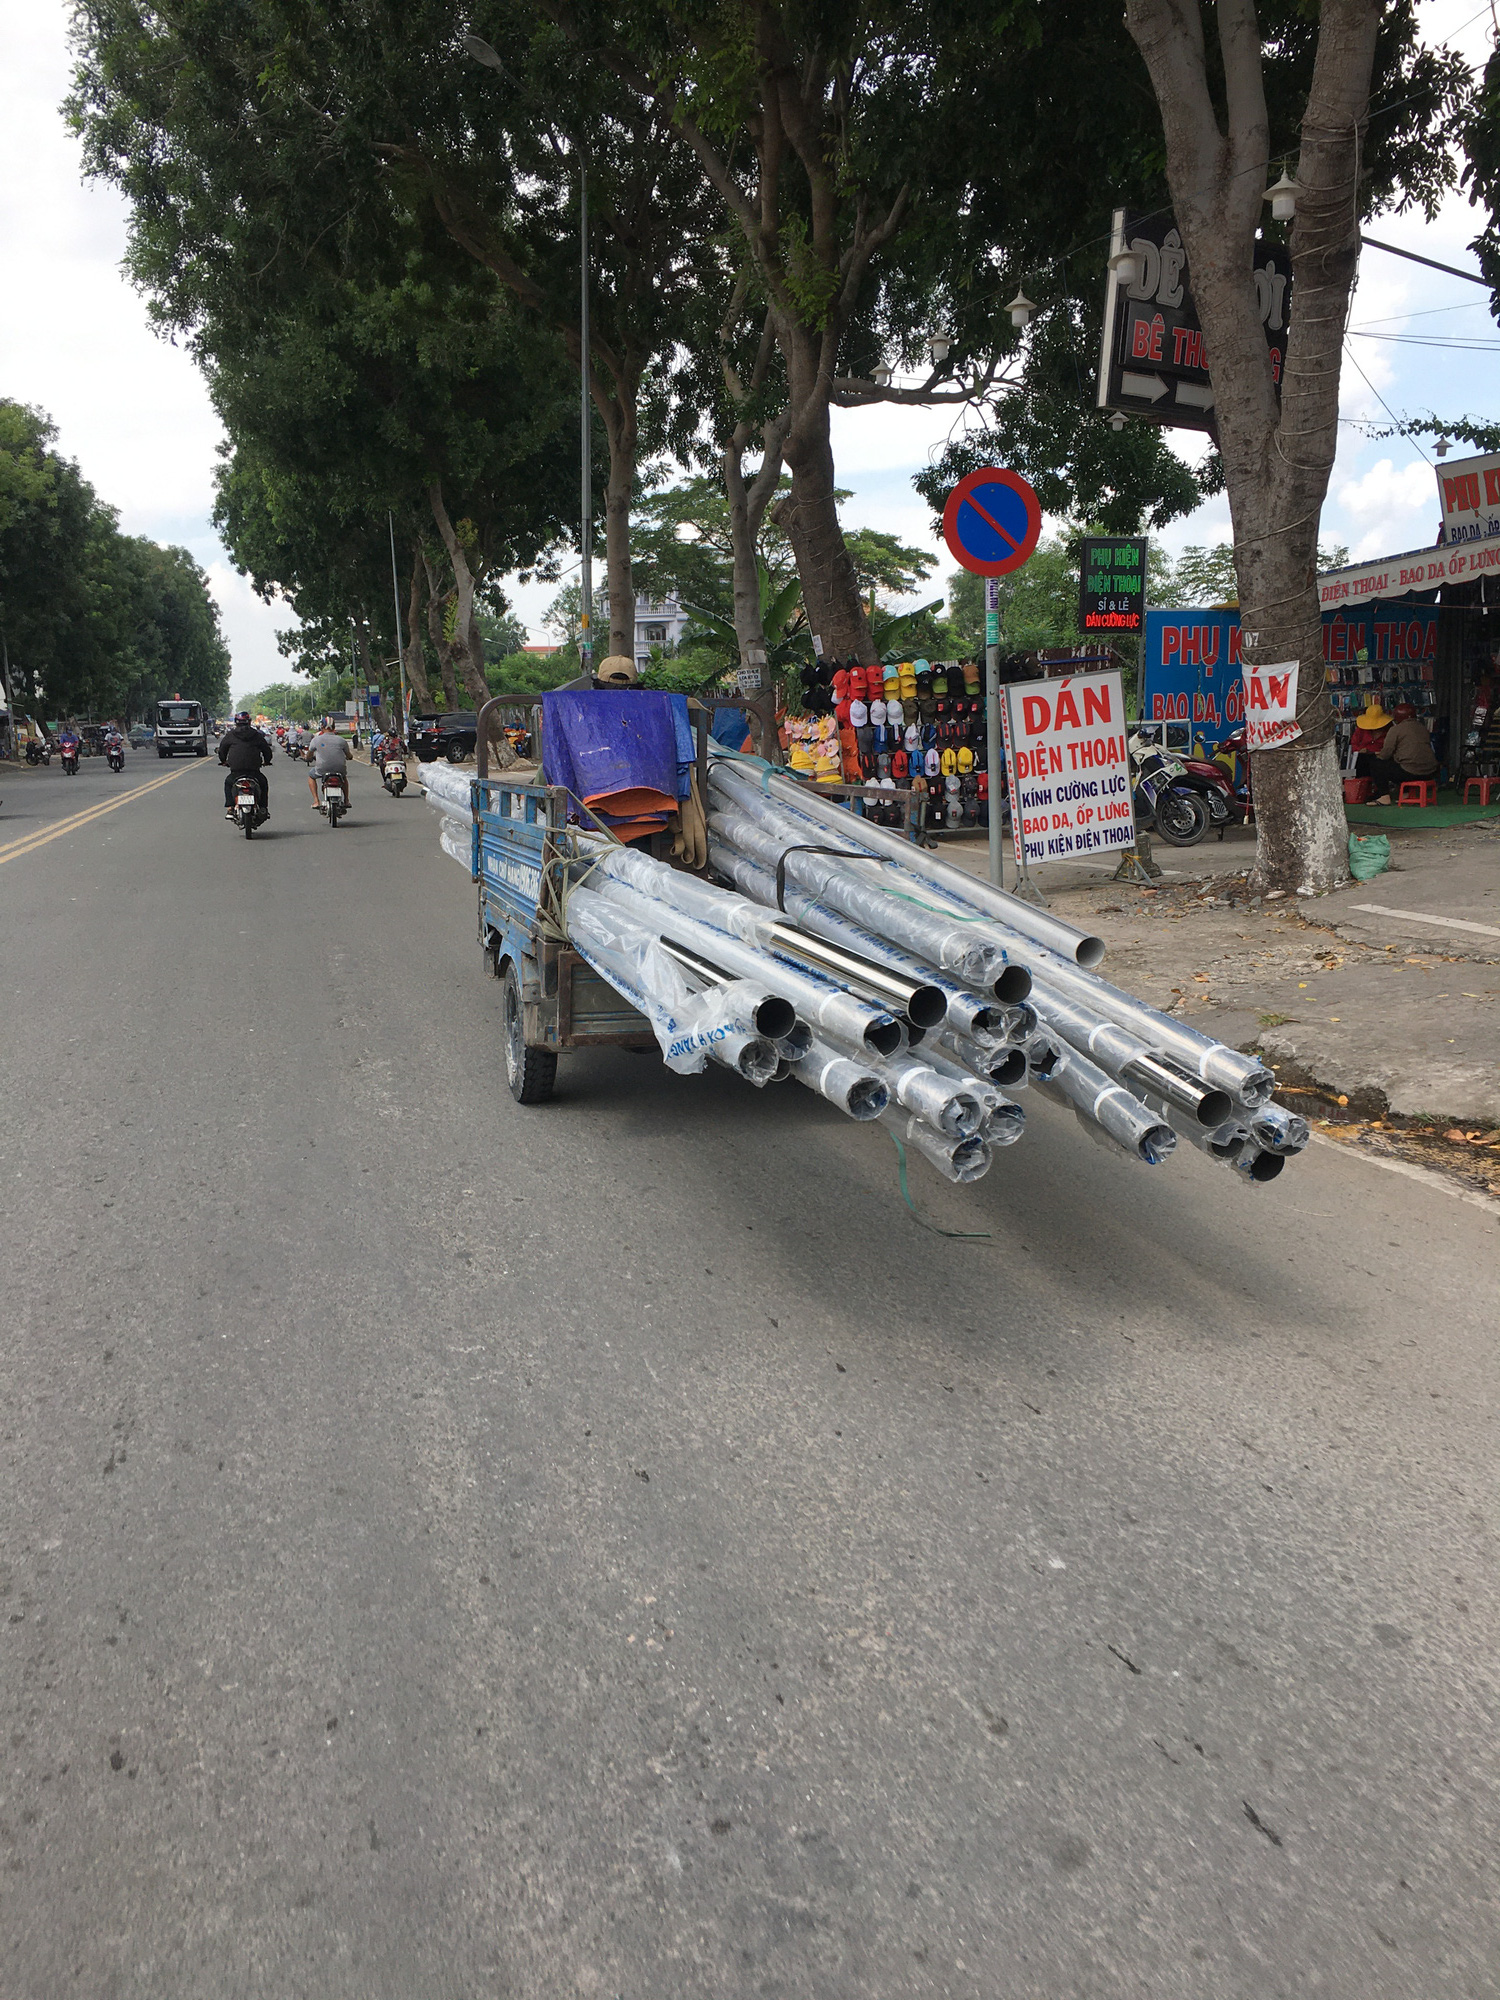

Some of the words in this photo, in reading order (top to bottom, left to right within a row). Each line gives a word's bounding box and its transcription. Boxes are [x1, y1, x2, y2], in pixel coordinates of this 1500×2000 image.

[1132, 313, 1166, 361] BÊ
[1443, 472, 1480, 518] PHỤ
[1090, 548, 1112, 569] PHỤ
[1114, 544, 1139, 569] KIỆN
[1087, 571, 1111, 595] ĐIỆN
[1112, 574, 1141, 595] THOẠI
[1321, 580, 1350, 603] ĐIỆN
[1352, 573, 1389, 594] THOẠI
[1399, 565, 1425, 586] BAO
[1427, 561, 1446, 580] DA
[1448, 550, 1467, 575] ỐP
[1086, 611, 1101, 627] DÁN
[1126, 612, 1140, 629] LỰC
[1108, 600, 1116, 611] &
[1118, 596, 1129, 611] LẺ
[1161, 626, 1220, 677] PHỤ
[1373, 620, 1438, 667] THOẠ
[1022, 679, 1112, 736] DÁN
[1152, 692, 1189, 722] BAO
[1193, 693, 1221, 729] DA,
[1016, 741, 1062, 781] ĐIỆN
[1067, 735, 1126, 769] THOẠI
[1022, 788, 1053, 808] KÍNH
[1056, 780, 1098, 802] CƯỜNG
[1101, 774, 1126, 796] LỰC
[1023, 816, 1048, 834] BAO
[1052, 812, 1073, 830] DA,
[1076, 803, 1094, 825] ỐP
[1097, 801, 1130, 821] LƯNG
[1025, 841, 1044, 859] PHỤ
[1048, 833, 1073, 856] KIỆN
[1076, 828, 1100, 851] ĐIỆN
[1103, 825, 1134, 844] THOẠI
